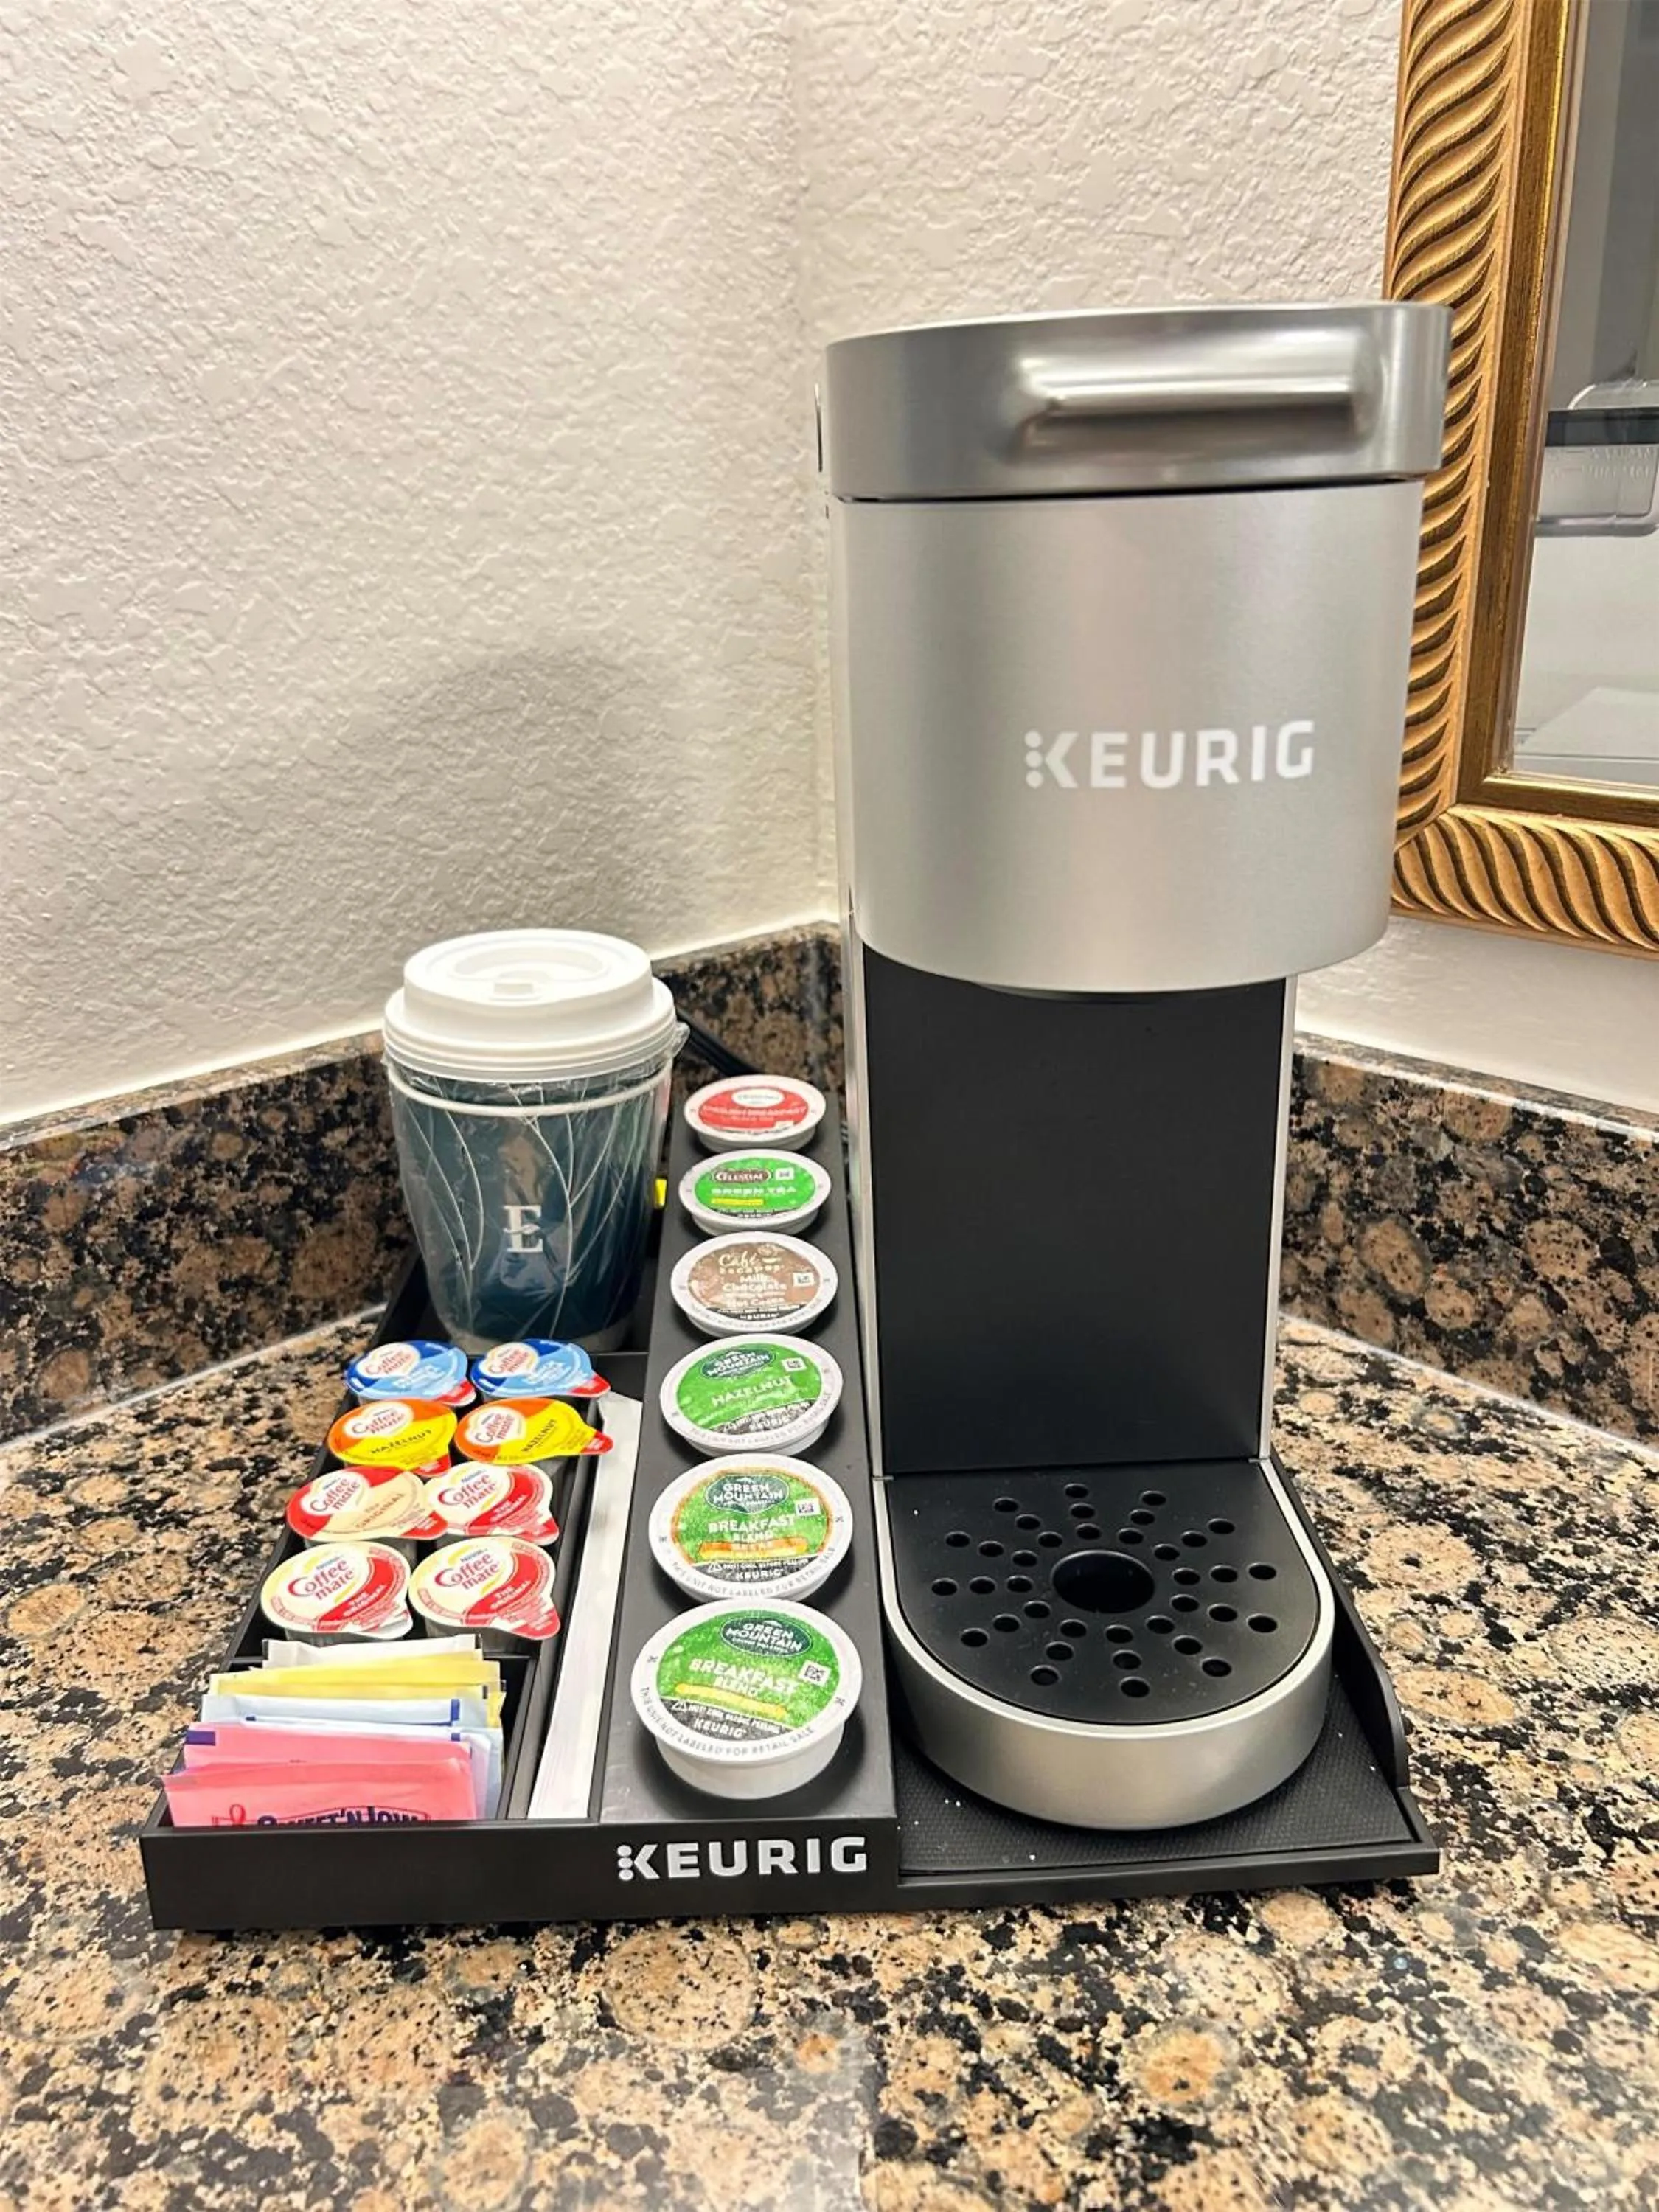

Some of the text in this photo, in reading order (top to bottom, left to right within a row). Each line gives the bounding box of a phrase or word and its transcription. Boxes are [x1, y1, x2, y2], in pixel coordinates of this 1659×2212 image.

[1024, 720, 1315, 789] KEURIG
[503, 1205, 543, 1253] E
[711, 1375, 790, 1407] HAZELNUT
[352, 1409, 400, 1435] Coffee
[474, 1413, 505, 1444] Coffee
[521, 1418, 558, 1453] HAZELNUT
[371, 1429, 432, 1454] HAZELNUT
[310, 1478, 351, 1512] Coffee
[332, 1481, 360, 1511] mate
[437, 1474, 491, 1506] Coffee
[462, 1483, 496, 1509] mate
[712, 1489, 784, 1504] MOUNTAIN
[723, 1483, 770, 1493] GREEN
[355, 1492, 405, 1528] ORIGINAL
[708, 1514, 796, 1534] BREAKFAST
[732, 1530, 774, 1542] BLEND
[287, 1559, 347, 1598] Coffee
[434, 1553, 494, 1587] Coffee
[462, 1562, 500, 1590] mate
[736, 1568, 784, 1581] KEURIG
[315, 1570, 355, 1601] mate
[725, 1627, 804, 1652] MOUNTAIN
[742, 1622, 795, 1640] GREEN
[688, 1658, 800, 1695] BREAKFAST
[713, 1675, 759, 1697] BLEND
[661, 1722, 679, 1738] NOT
[677, 1733, 723, 1755] LABELED
[725, 1747, 749, 1756] FOR
[751, 1740, 790, 1753] RETAIL
[693, 1718, 746, 1739] KEURIG
[617, 1836, 868, 1882] KEURIG
